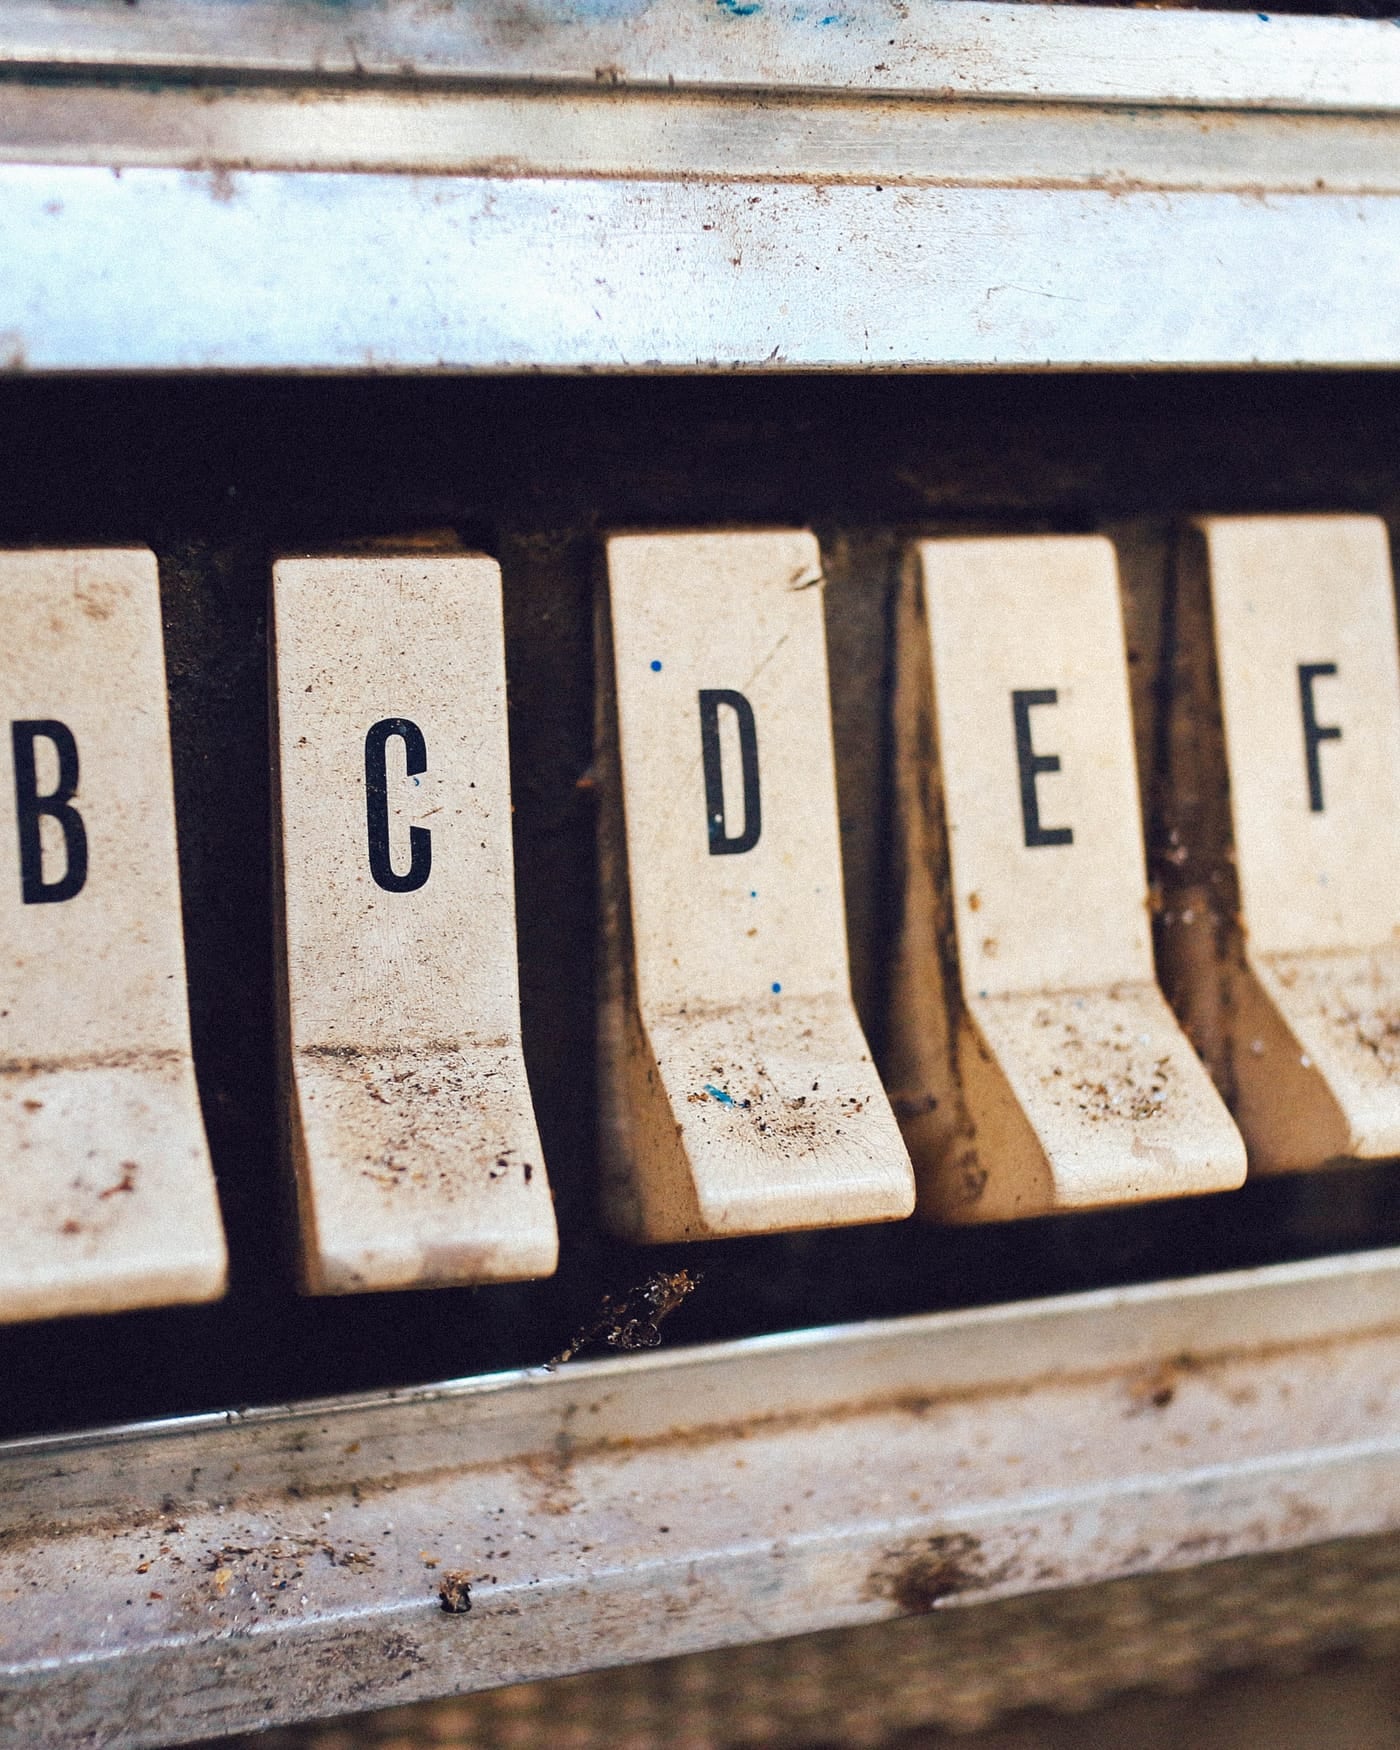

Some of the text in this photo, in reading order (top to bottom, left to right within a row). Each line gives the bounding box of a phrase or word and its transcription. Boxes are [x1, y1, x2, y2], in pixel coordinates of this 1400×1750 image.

[11, 719, 89, 905] B
[364, 717, 432, 894] C
[698, 689, 762, 856] D
[1012, 688, 1074, 849] E
[1296, 662, 1341, 813] F
